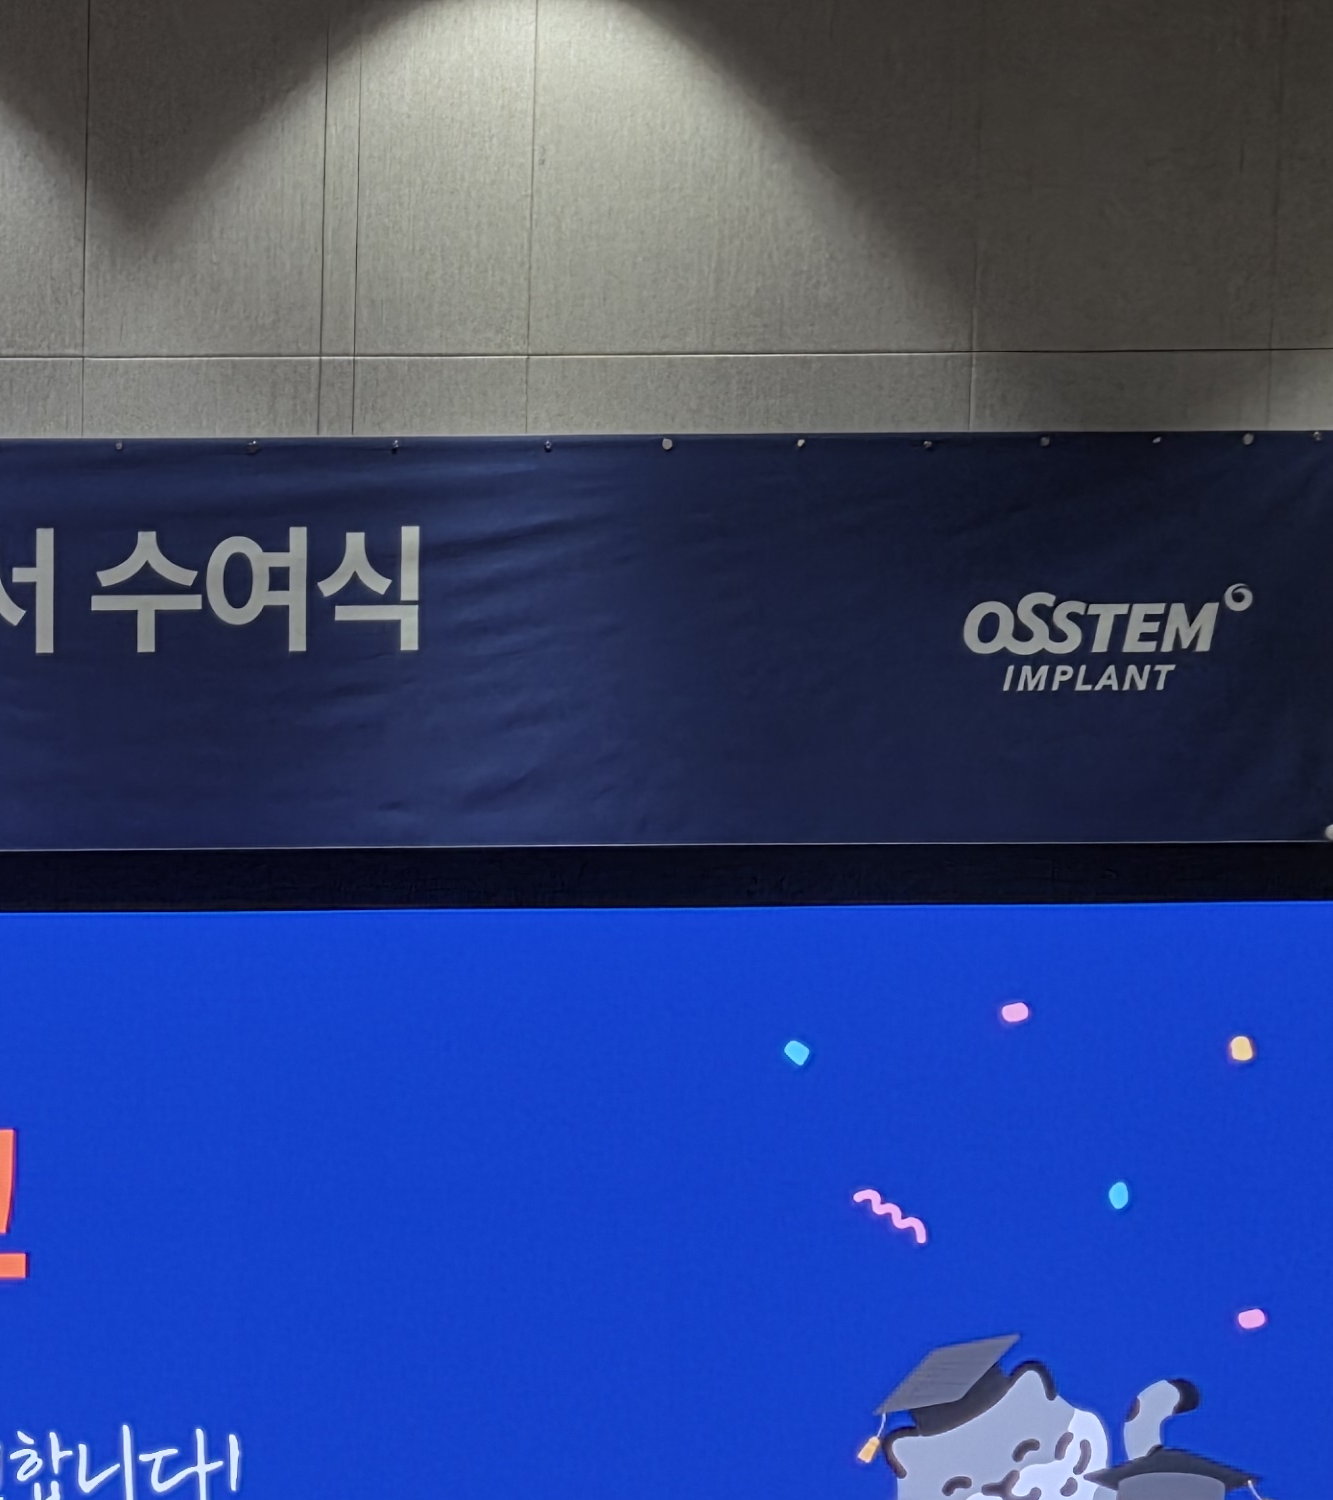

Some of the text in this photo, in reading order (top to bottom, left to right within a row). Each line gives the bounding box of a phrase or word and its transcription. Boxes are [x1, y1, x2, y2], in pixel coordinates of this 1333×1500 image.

[90, 525, 421, 653] 수여식
[963, 591, 1220, 656] OSSTEM
[1002, 664, 1176, 692] IMPLANT
